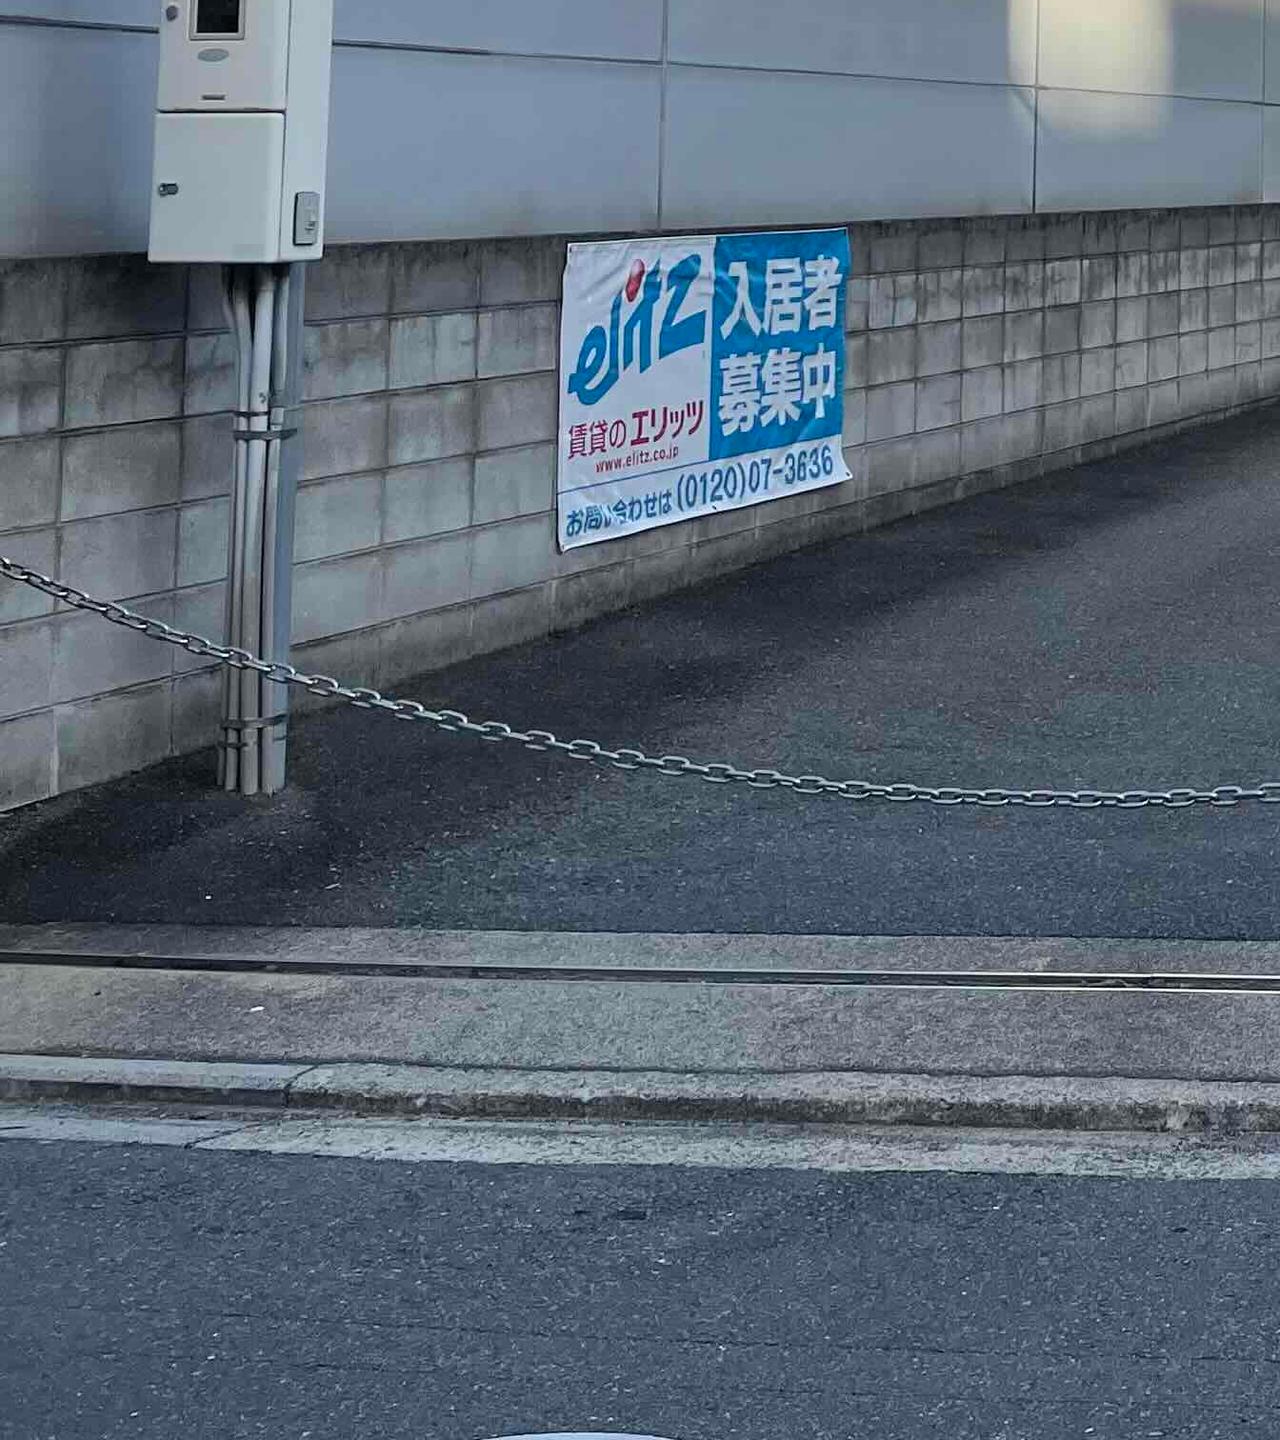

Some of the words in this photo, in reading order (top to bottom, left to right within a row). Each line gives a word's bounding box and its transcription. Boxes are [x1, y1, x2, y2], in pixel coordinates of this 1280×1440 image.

[719, 254, 843, 341] 入居者
[718, 342, 837, 437] 募集中
[565, 489, 673, 538] お問い合わせは
[676, 444, 834, 510] (0120)07-3636
[594, 445, 680, 474] www.elitz.co.jp
